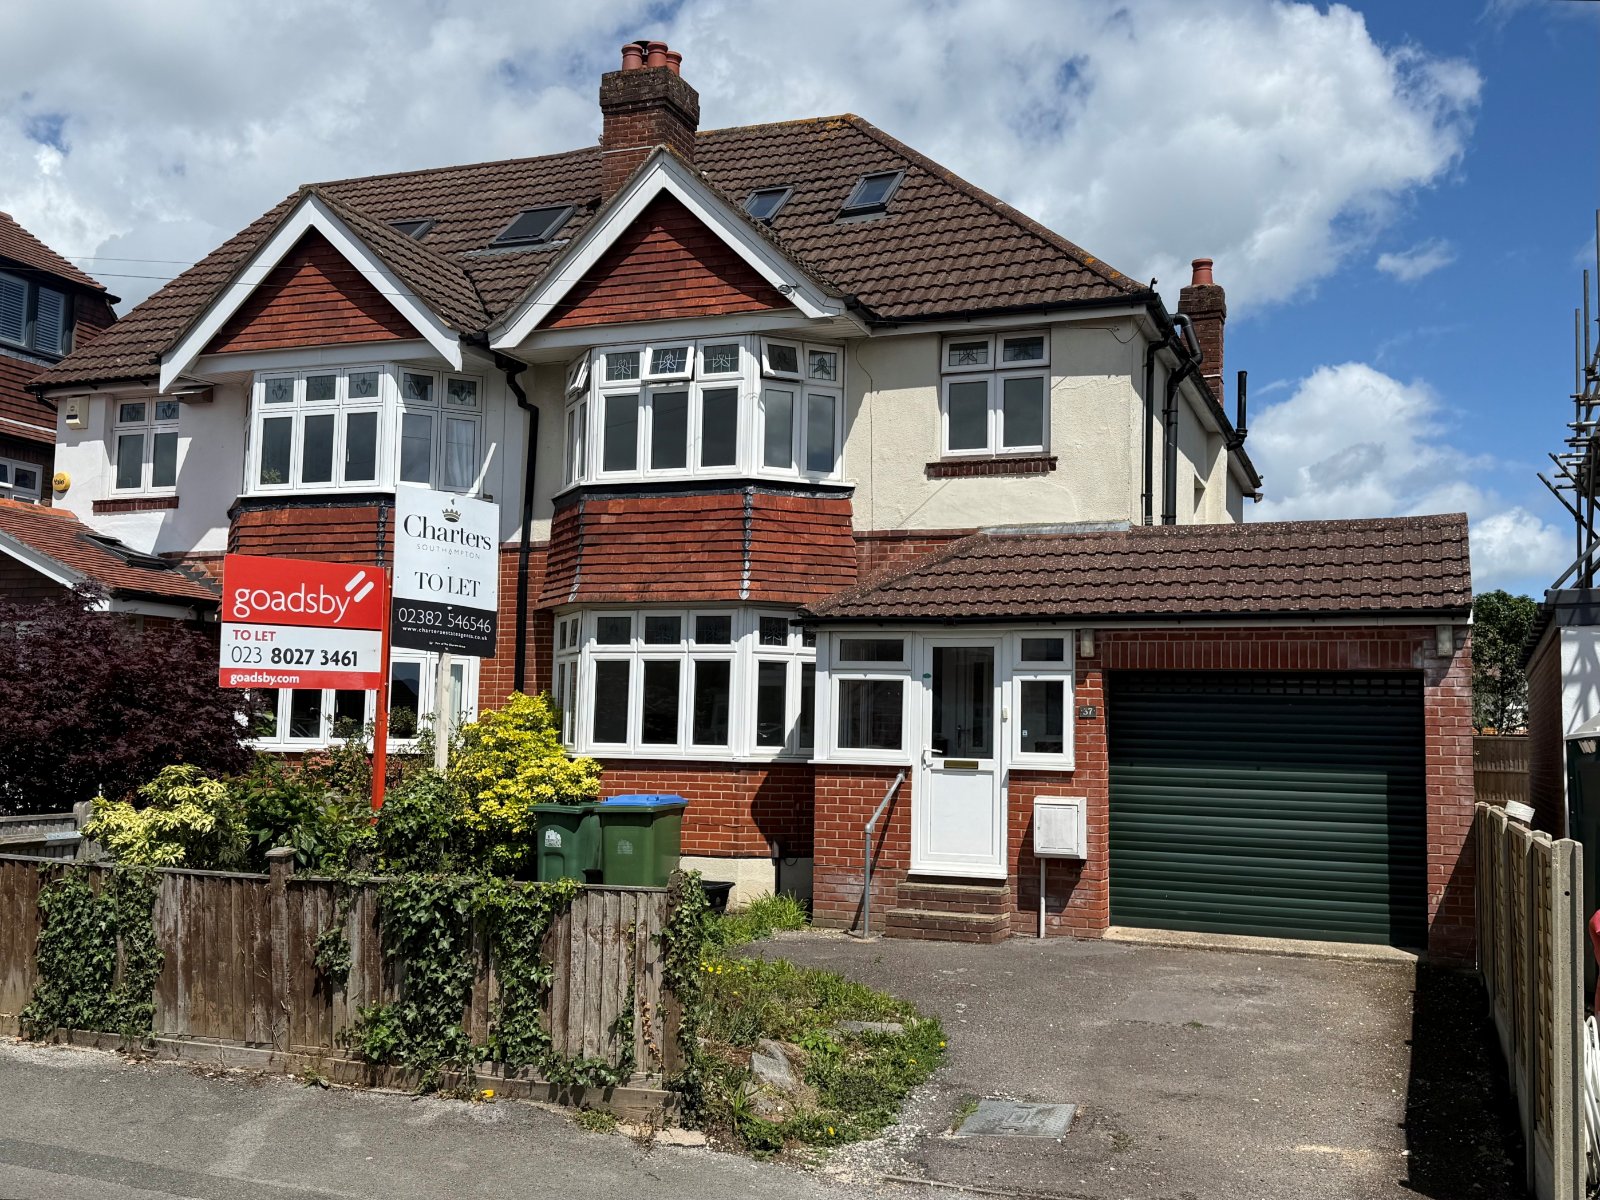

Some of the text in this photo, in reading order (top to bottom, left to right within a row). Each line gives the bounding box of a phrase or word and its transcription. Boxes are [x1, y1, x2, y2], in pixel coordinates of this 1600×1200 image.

[403, 513, 492, 551] Charters
[416, 544, 481, 560] SOUTHAMPTON
[415, 571, 481, 598] TO LET
[233, 582, 351, 624] goadsby
[398, 607, 492, 633] 02382 546546
[233, 630, 277, 642] TO LET
[231, 645, 358, 668] 023 8027 3461
[230, 671, 300, 685] goadsby.com
[1082, 707, 1093, 715] 37
